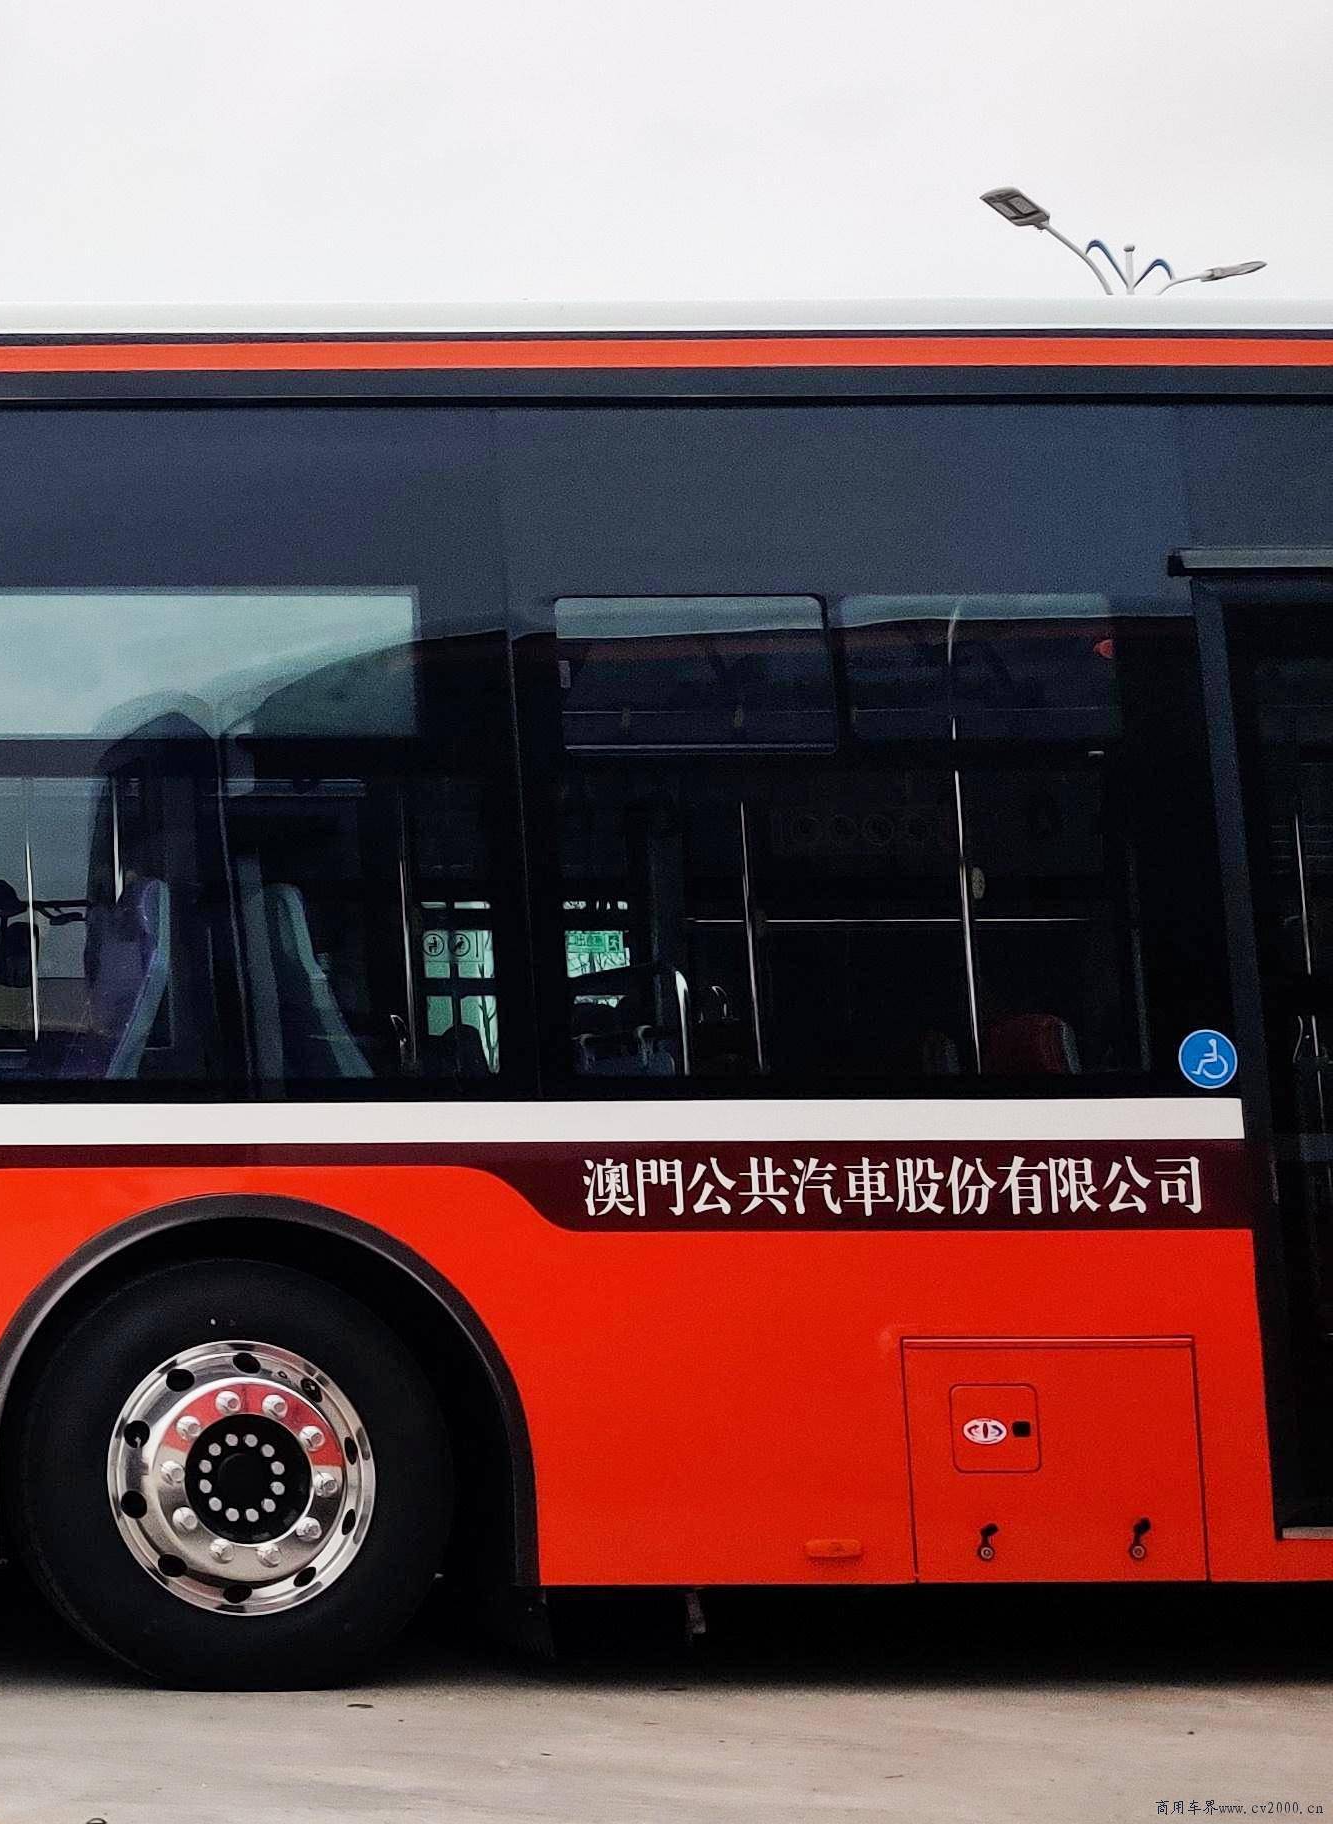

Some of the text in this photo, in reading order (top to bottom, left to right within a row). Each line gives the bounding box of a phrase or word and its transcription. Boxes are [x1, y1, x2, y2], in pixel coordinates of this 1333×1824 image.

[582, 1155, 1203, 1217] 澳門公共汽車股份有限公司
